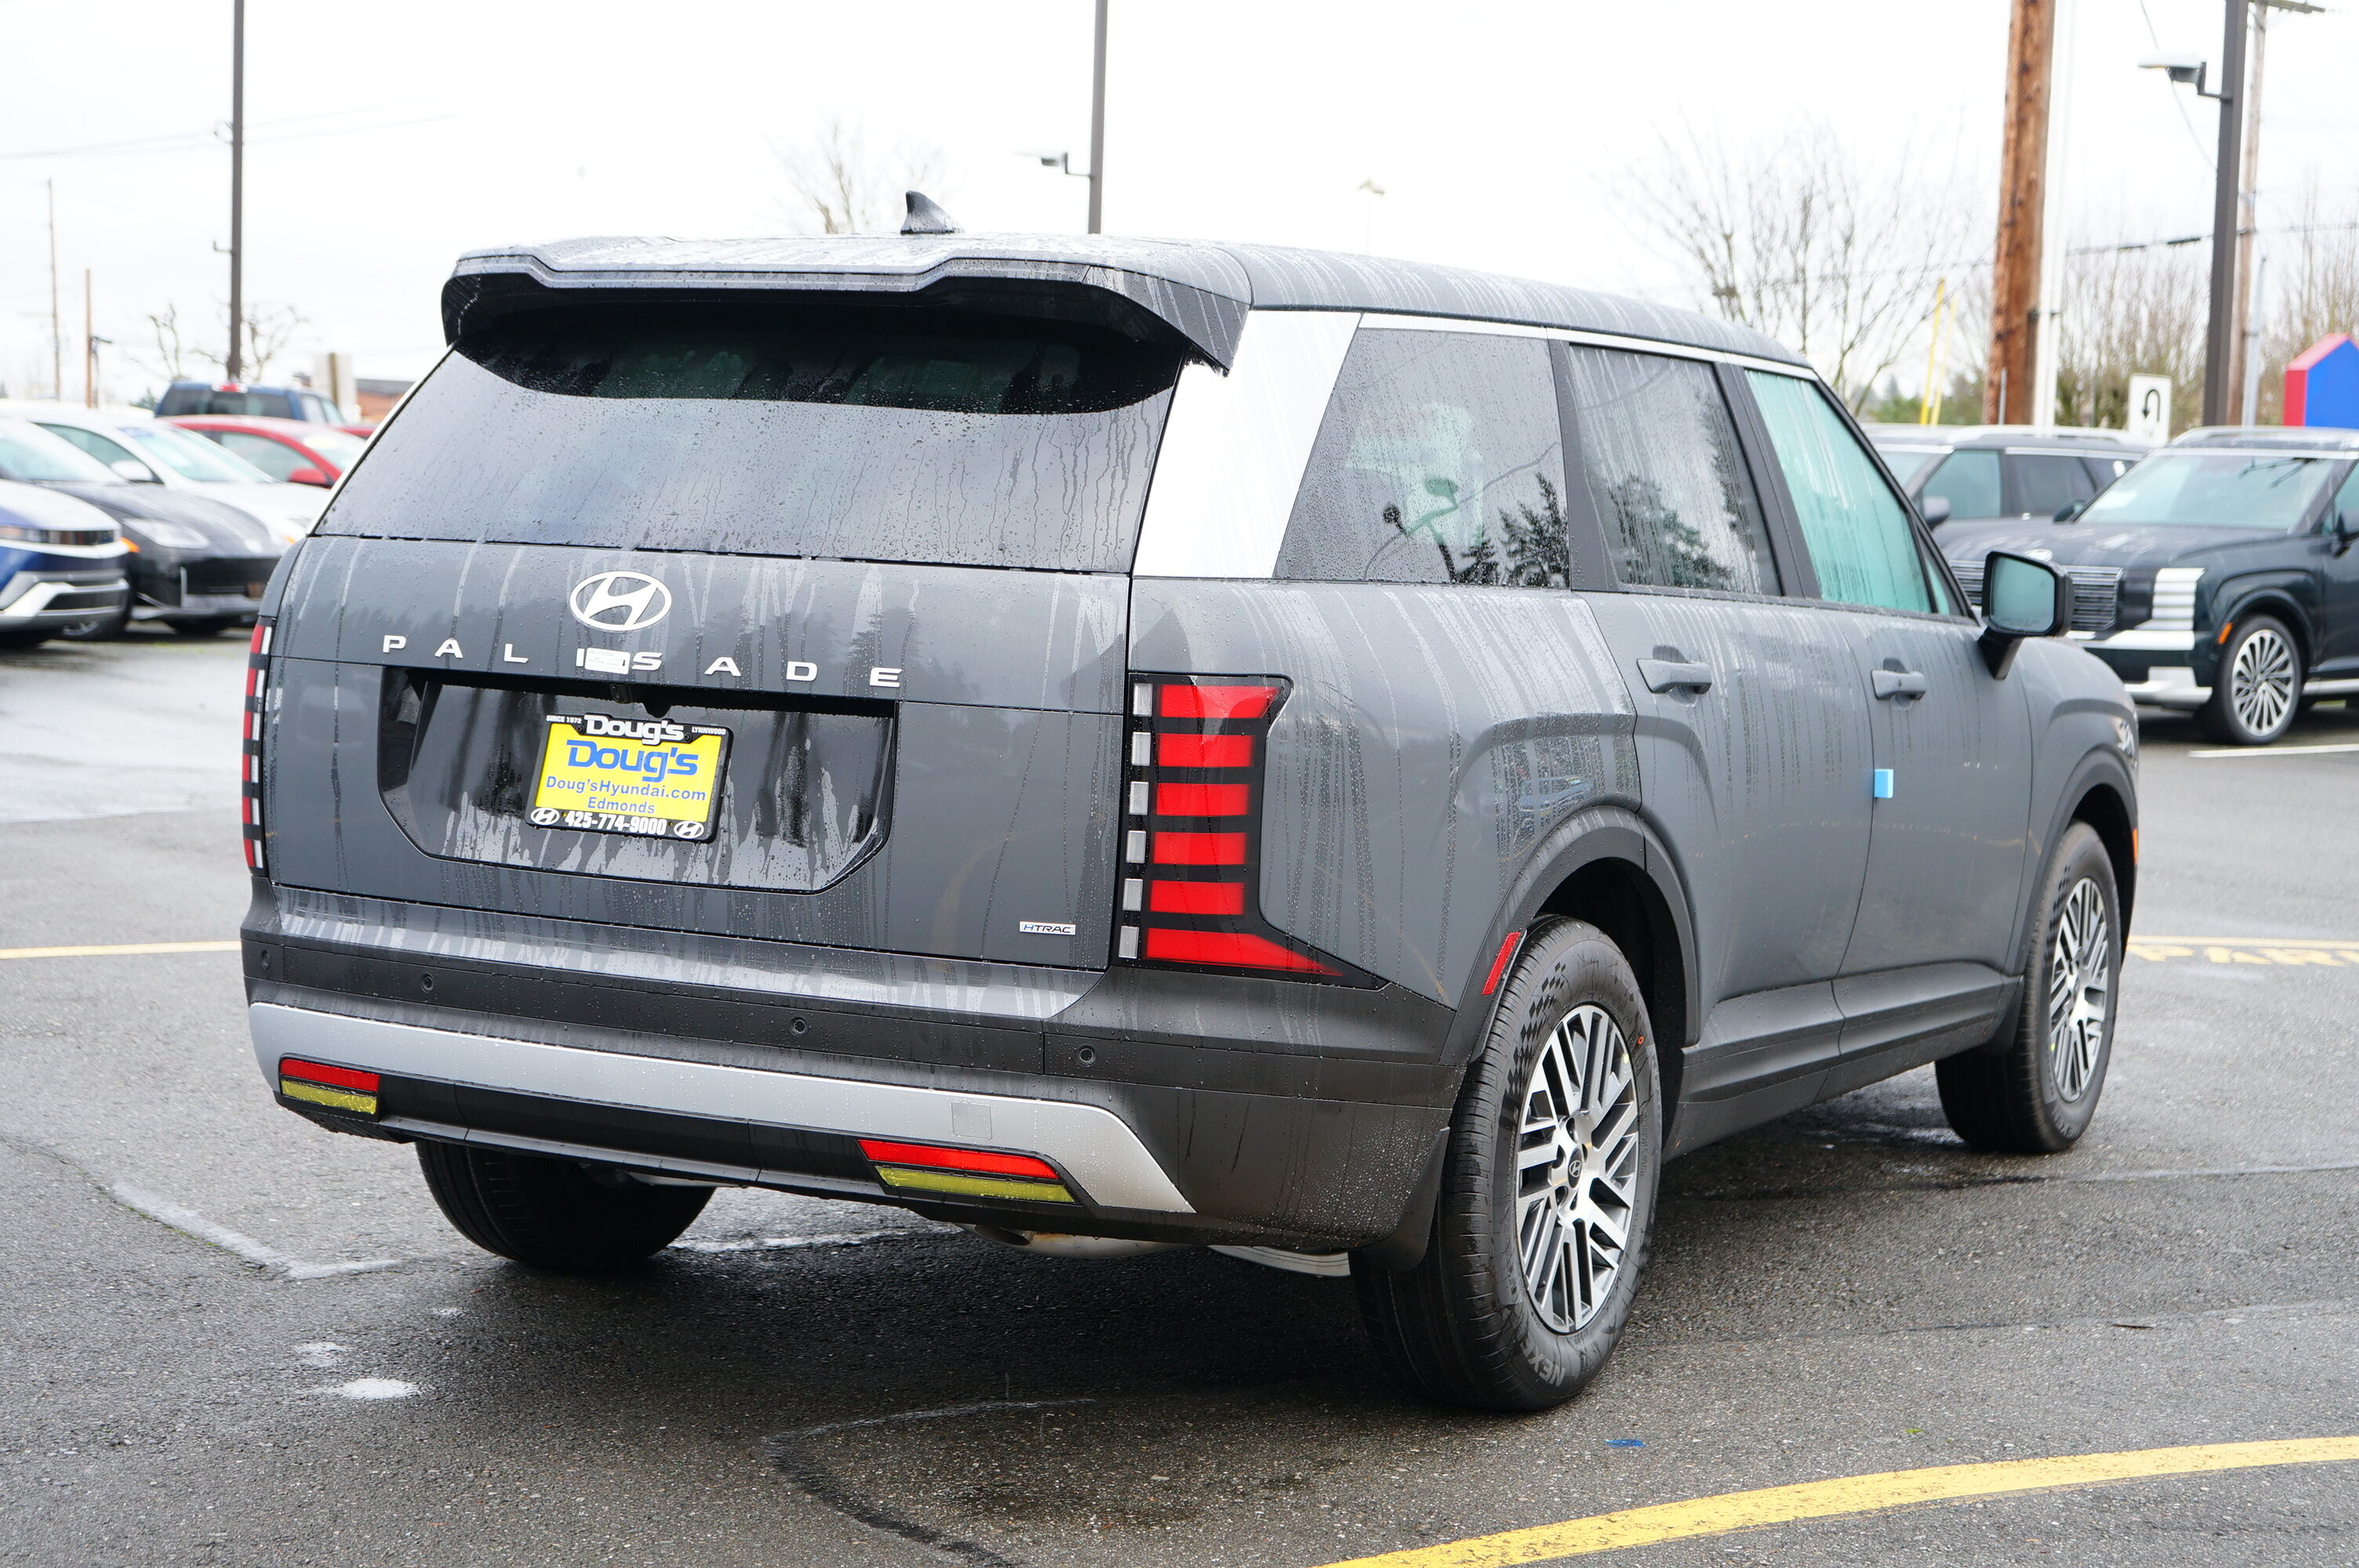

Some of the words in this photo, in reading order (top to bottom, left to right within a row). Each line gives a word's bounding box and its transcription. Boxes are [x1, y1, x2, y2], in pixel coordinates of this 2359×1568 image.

[383, 635, 903, 688] PALISADE
[546, 714, 565, 723] SINCE
[566, 716, 582, 724] 1972
[583, 714, 685, 746] Doug's
[692, 726, 726, 735] LYNNWOOD
[566, 739, 699, 782] Doug's
[546, 775, 707, 801] Doug'sHyundai.com
[587, 797, 656, 814] Edmonds
[564, 809, 667, 836] 425-774-9000
[1023, 924, 1071, 934] HTRAC
